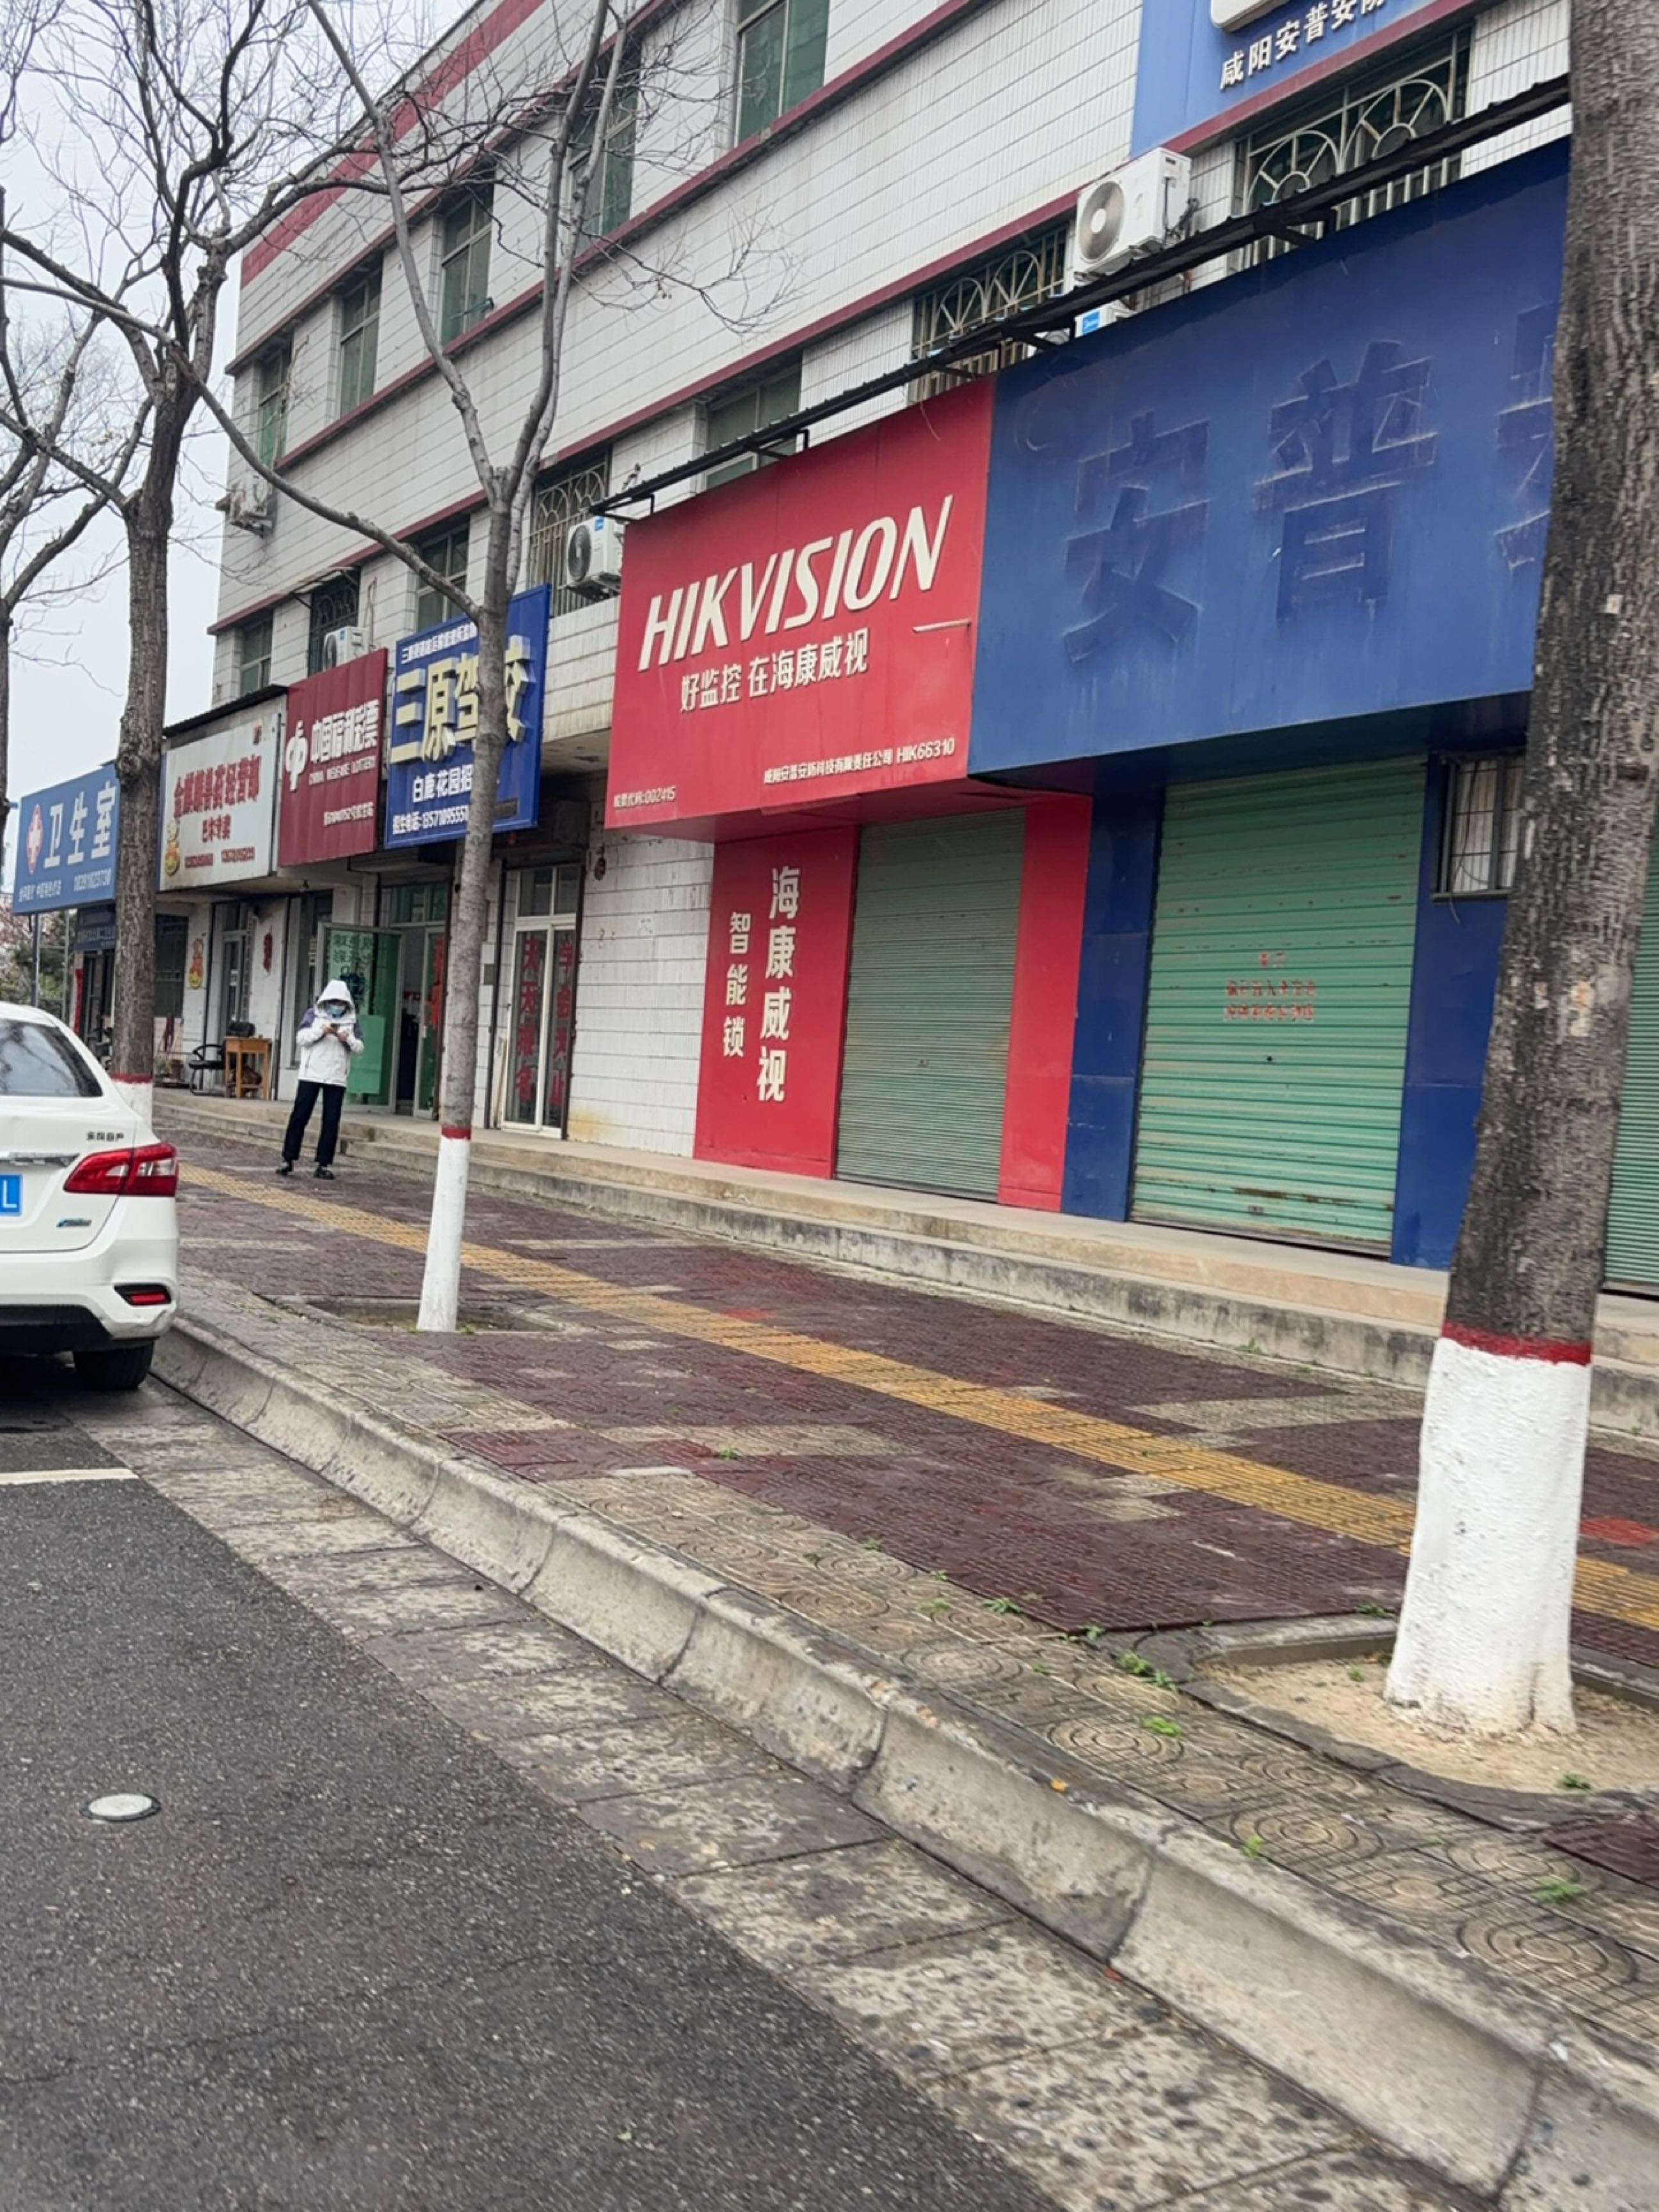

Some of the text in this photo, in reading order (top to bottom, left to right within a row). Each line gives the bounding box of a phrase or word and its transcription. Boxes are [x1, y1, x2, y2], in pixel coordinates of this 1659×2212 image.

[637, 494, 954, 672] HIKVISION
[680, 627, 869, 713] 好监控 在海康威视
[413, 764, 474, 803] 白鹿花园招
[896, 736, 956, 764] HIK66310
[43, 780, 117, 869] 卫生室
[723, 911, 751, 1058] 智能锁
[756, 865, 801, 1103] 海康威视
